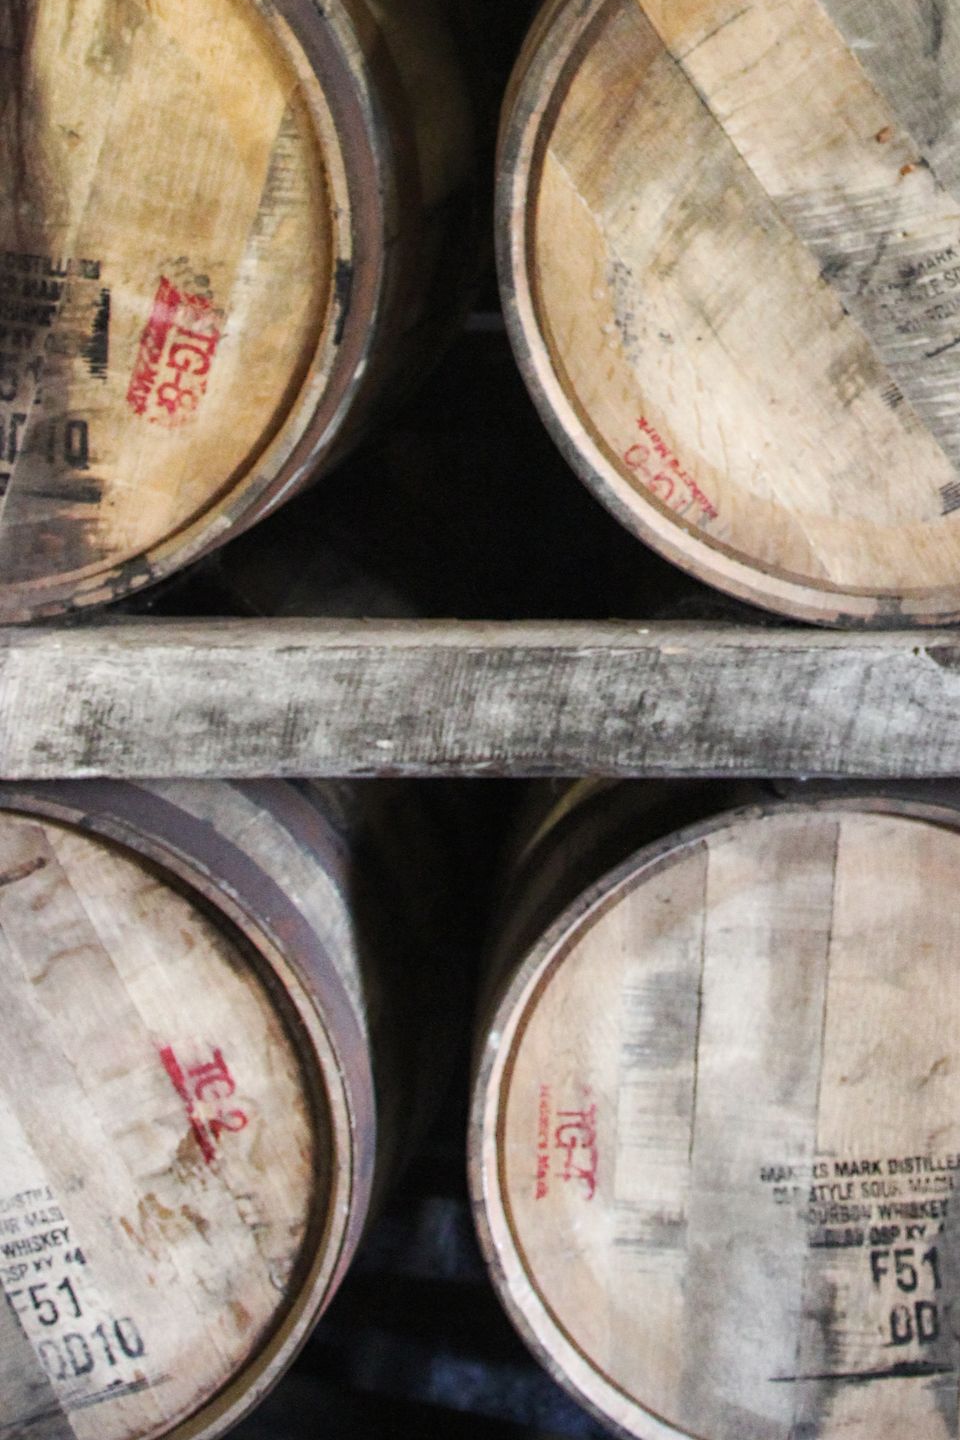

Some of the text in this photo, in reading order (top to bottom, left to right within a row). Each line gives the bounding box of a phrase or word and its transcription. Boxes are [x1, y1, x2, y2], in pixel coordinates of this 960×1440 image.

[834, 1158, 882, 1180] MARK
[0, 1227, 71, 1259] WHISKEY
[869, 1244, 942, 1294] F51
